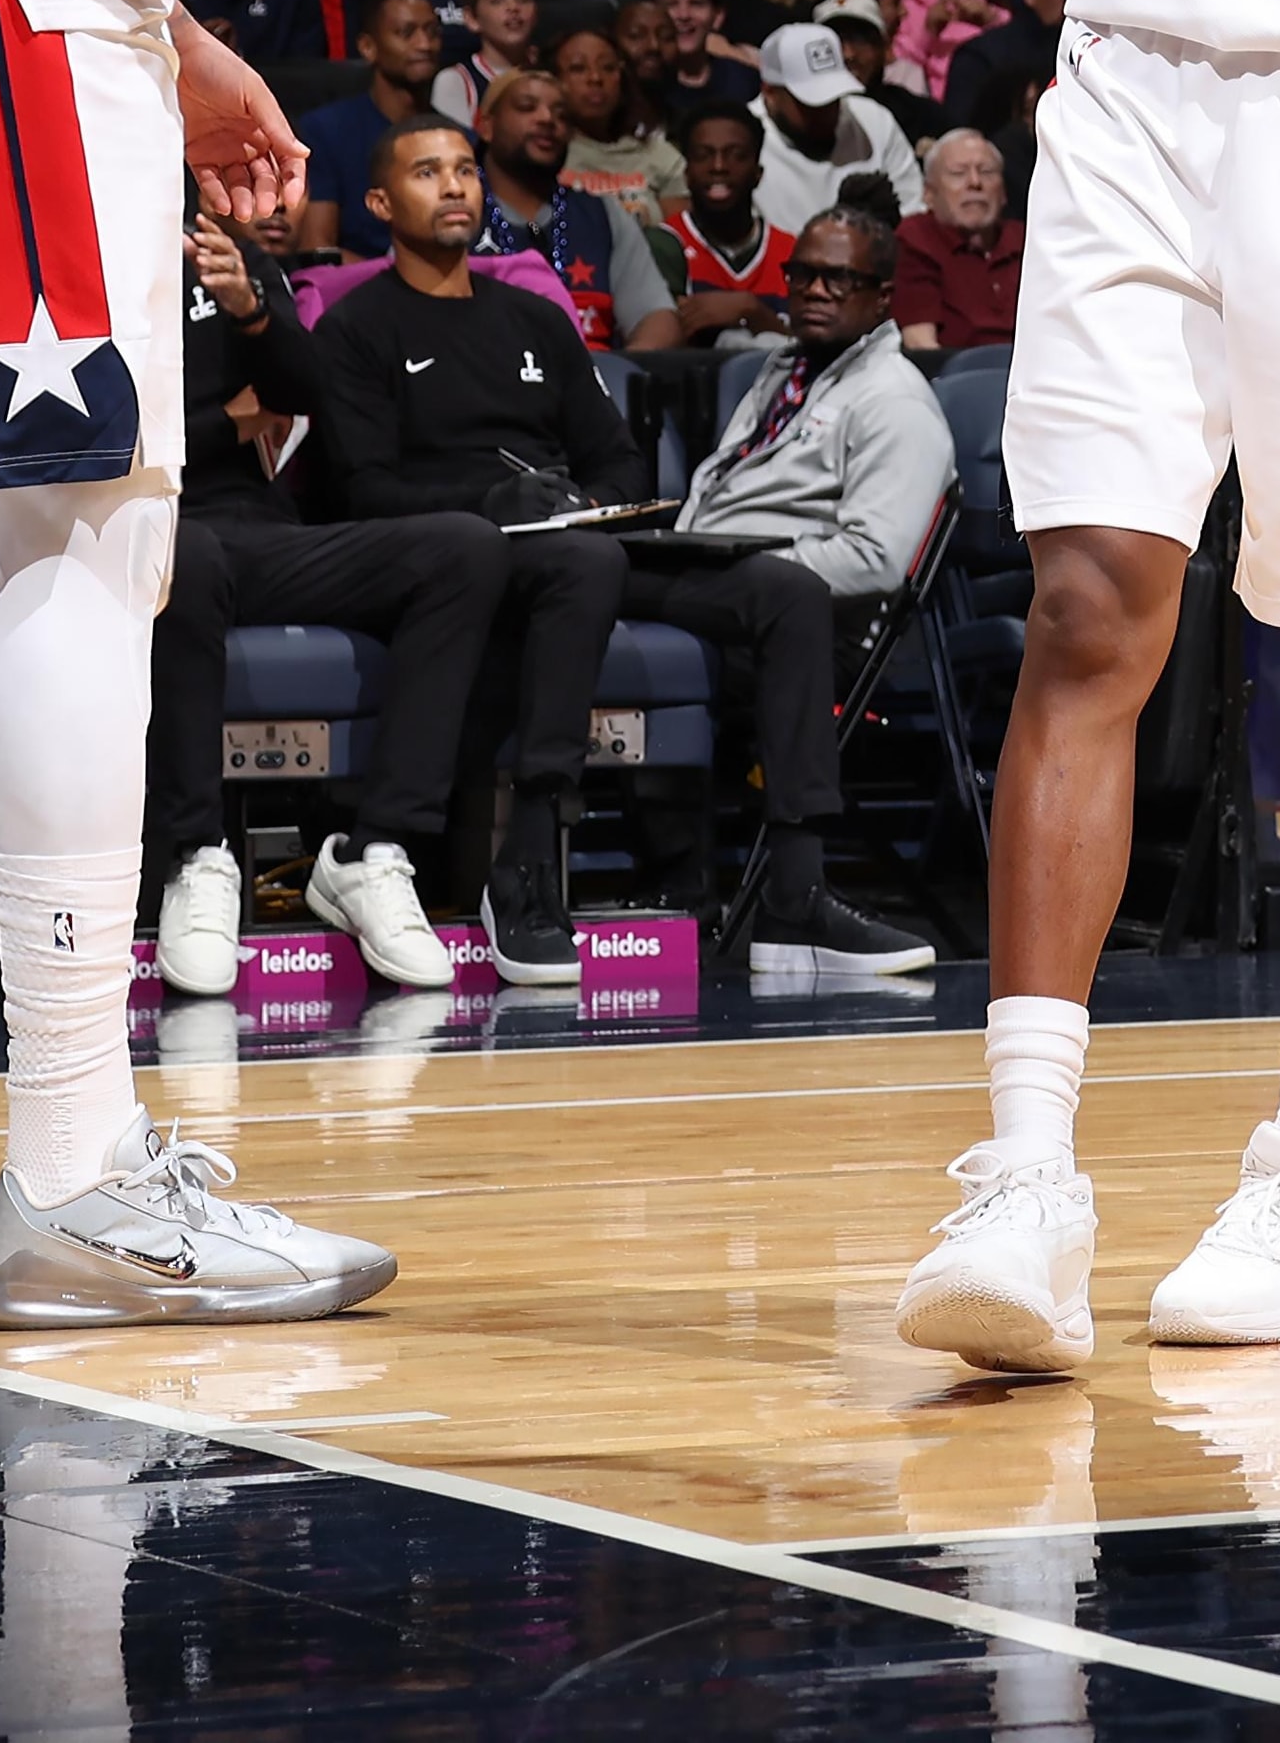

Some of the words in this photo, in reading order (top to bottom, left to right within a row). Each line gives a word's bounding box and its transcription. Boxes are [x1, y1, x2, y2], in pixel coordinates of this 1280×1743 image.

[448, 939, 493, 965] ido
[591, 932, 661, 958] leidos
[261, 947, 333, 974] leidos
